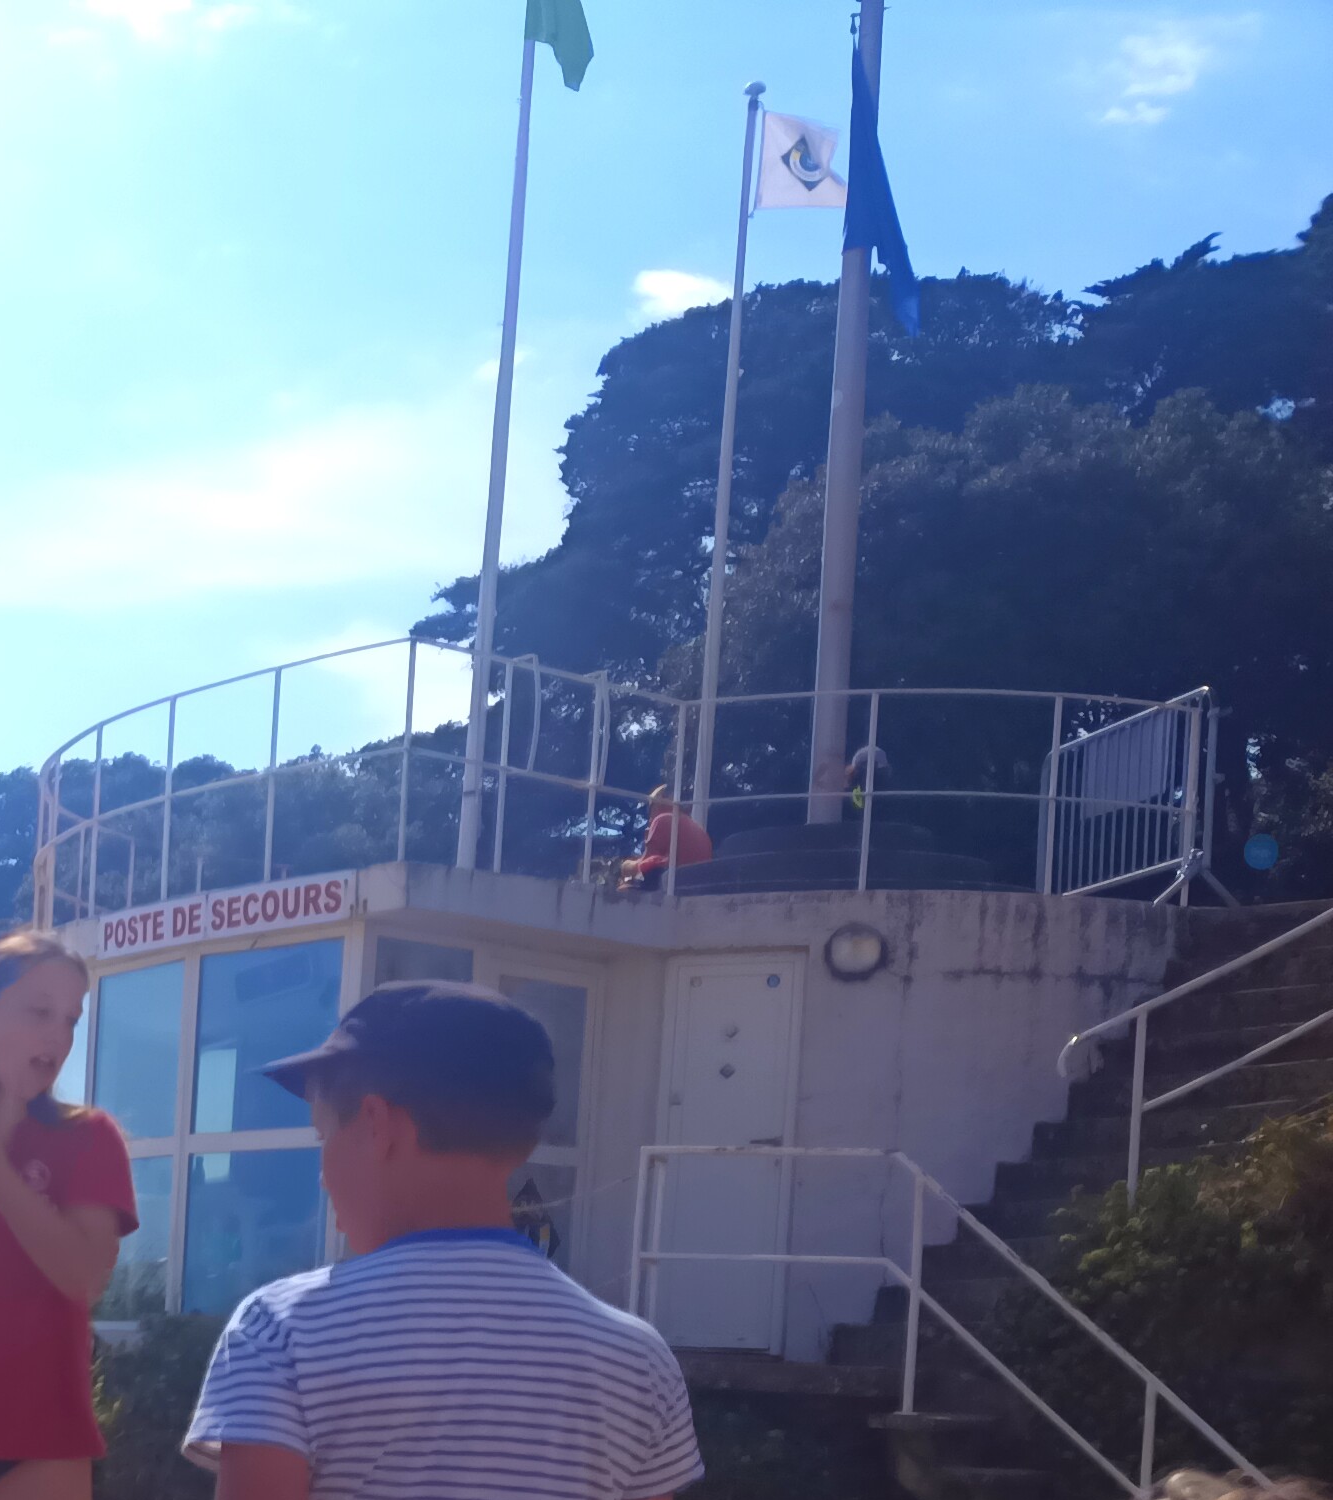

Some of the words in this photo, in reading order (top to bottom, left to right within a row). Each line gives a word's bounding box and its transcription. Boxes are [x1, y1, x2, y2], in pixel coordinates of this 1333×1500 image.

[104, 910, 164, 951] POSTE
[172, 902, 203, 938] DE
[211, 880, 343, 930] SECOURS
